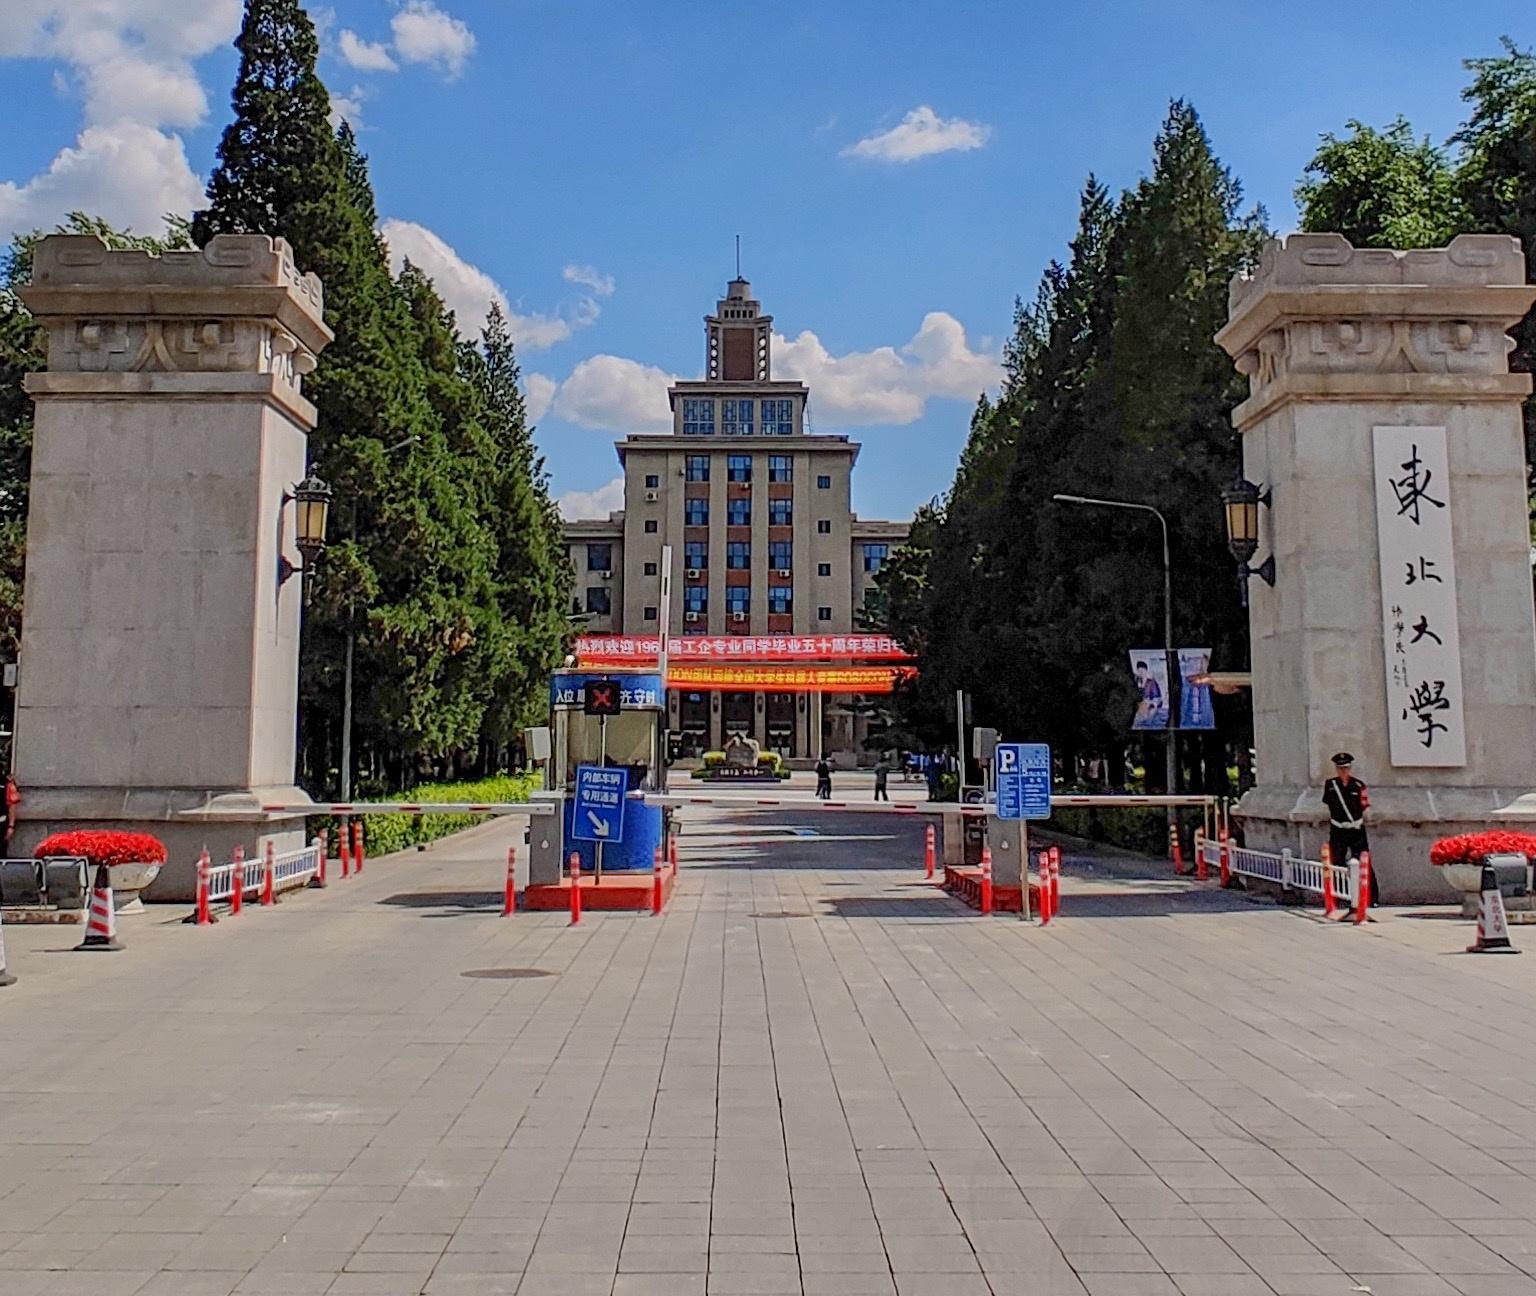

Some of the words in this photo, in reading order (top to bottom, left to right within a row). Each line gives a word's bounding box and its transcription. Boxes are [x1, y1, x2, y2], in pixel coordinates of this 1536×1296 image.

[576, 638, 904, 654] 热烈欢迎196届工企专业同学毕业五十周年荣归
[999, 749, 1016, 773] P
[582, 771, 621, 785] 内部车辆
[581, 789, 619, 804] 专用通道
